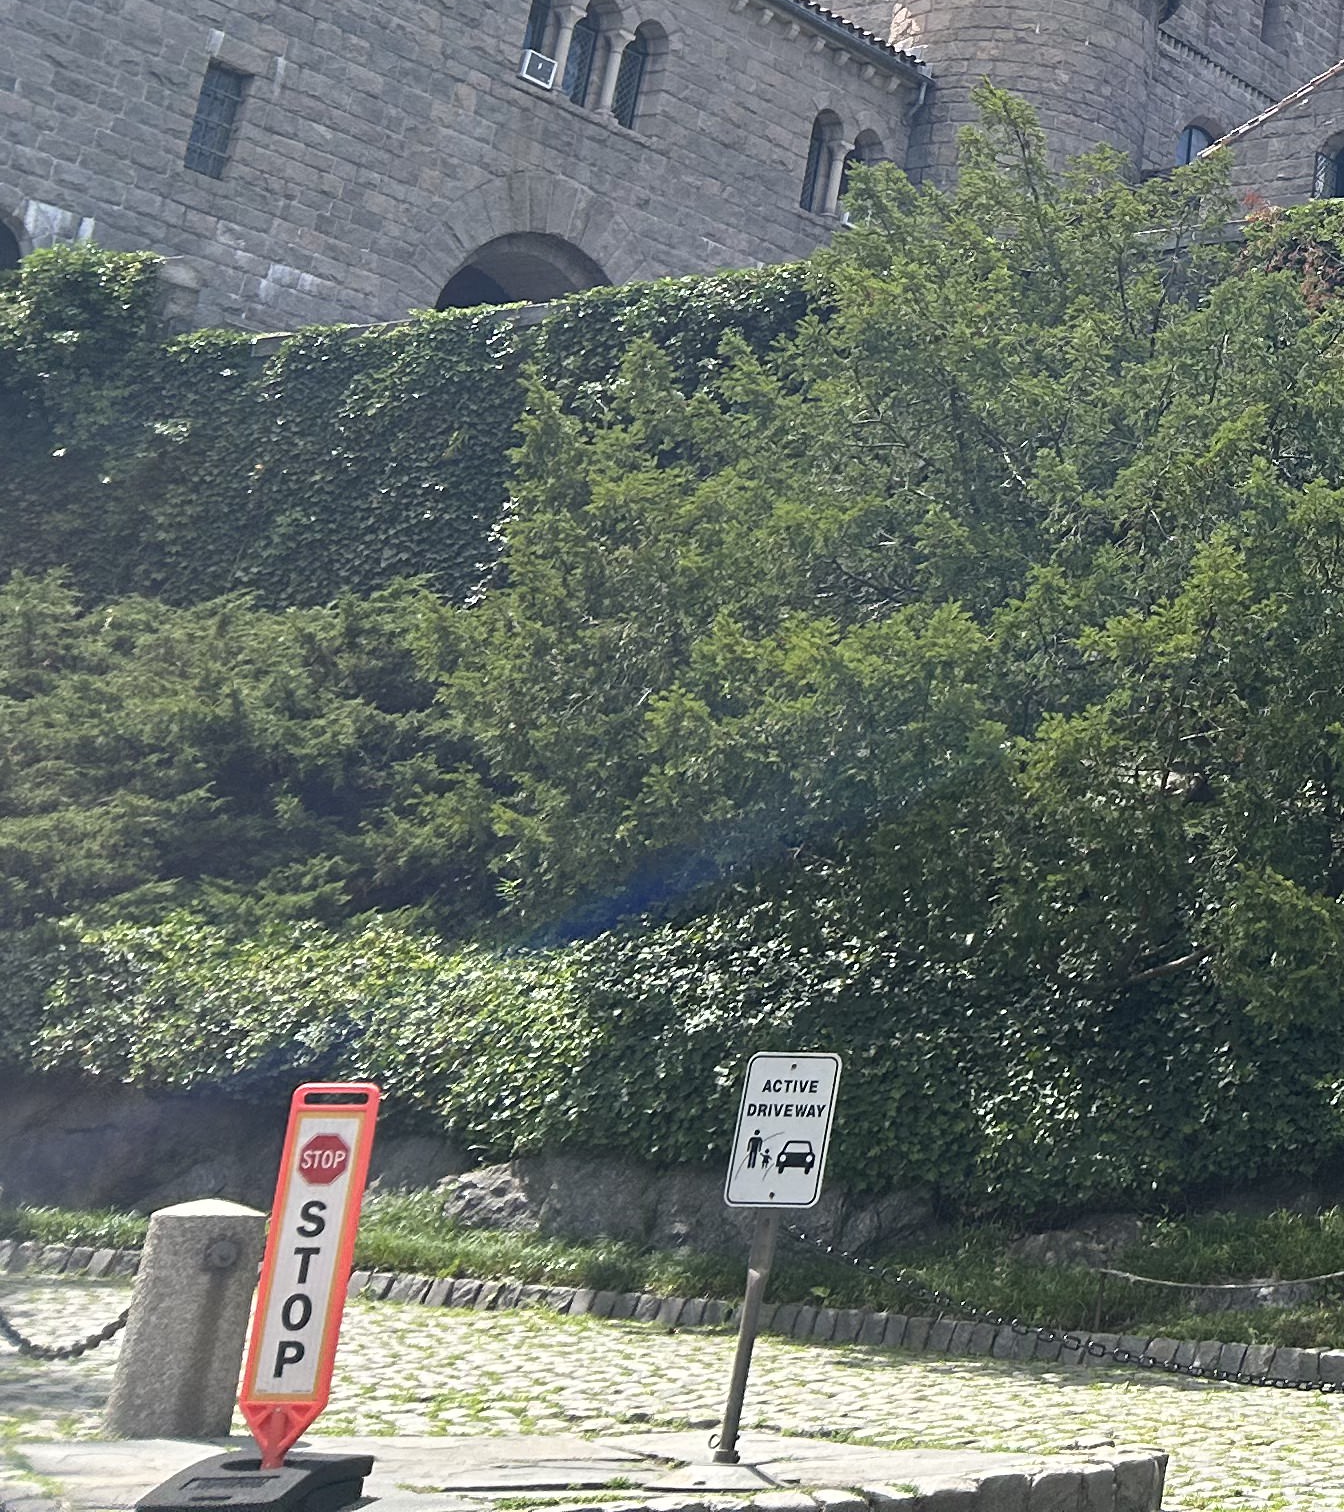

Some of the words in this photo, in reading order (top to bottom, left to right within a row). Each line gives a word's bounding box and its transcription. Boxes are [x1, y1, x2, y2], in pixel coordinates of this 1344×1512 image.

[762, 1079, 819, 1093] ACTIVE
[747, 1103, 826, 1118] DRIVEWAY
[300, 1148, 346, 1170] STOP
[272, 1200, 327, 1378] STOP
